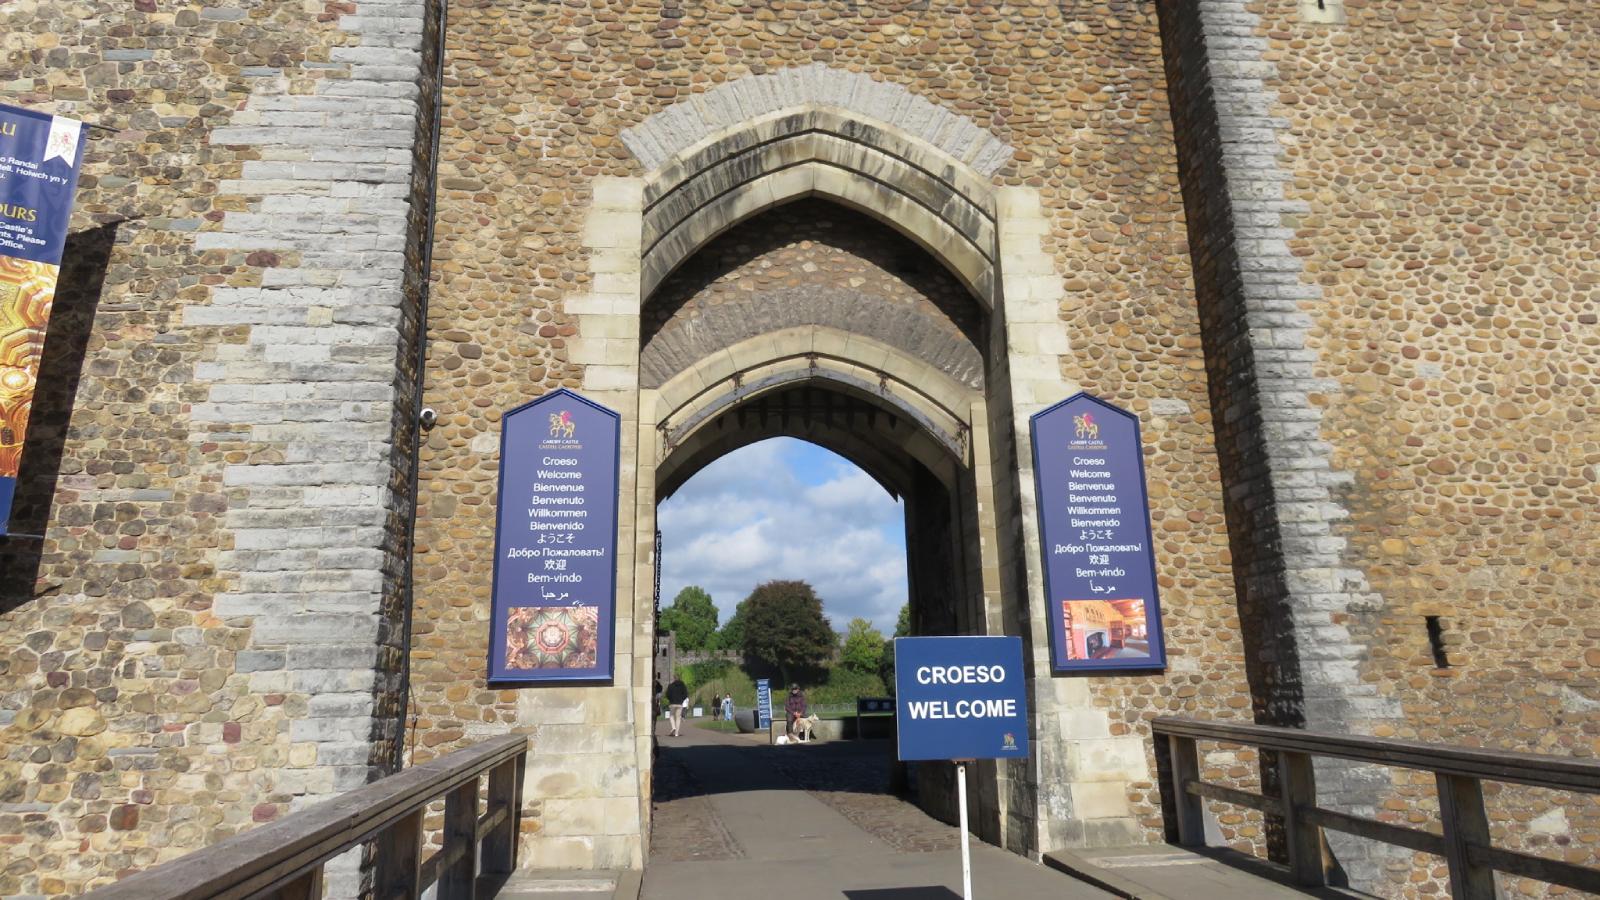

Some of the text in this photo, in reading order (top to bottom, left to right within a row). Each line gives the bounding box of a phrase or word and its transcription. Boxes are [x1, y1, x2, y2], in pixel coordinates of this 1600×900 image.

[16, 168, 49, 180] Holwch
[50, 175, 61, 183] yn
[16, 234, 46, 246] Please
[542, 457, 578, 466] Croeso
[1073, 457, 1105, 466] Croeso
[537, 470, 582, 479] Welcome
[1070, 470, 1111, 478] Welcome
[533, 483, 584, 492] Bienvenue
[1068, 482, 1115, 491] Bienvenue
[532, 496, 584, 505] Benvenuto
[1069, 494, 1116, 503] Benvenuto
[528, 509, 587, 518] Willkommen
[1067, 506, 1121, 515] Willkommen
[530, 522, 584, 531] Bienvenido
[1071, 518, 1120, 528] Bienvenido
[537, 533, 575, 544] ようこそ
[1079, 530, 1114, 540] ようこそ
[507, 547, 605, 558] Добро Пожаловать!
[1055, 543, 1142, 554] Добро Пожаловать!
[1089, 554, 1110, 565] 欢迎
[544, 559, 567, 571] 欢迎
[528, 573, 582, 583] Bem-vindo
[1076, 568, 1125, 578] Bem-vindo
[917, 665, 1005, 684] CROESO
[908, 699, 1017, 719] WELCOME
